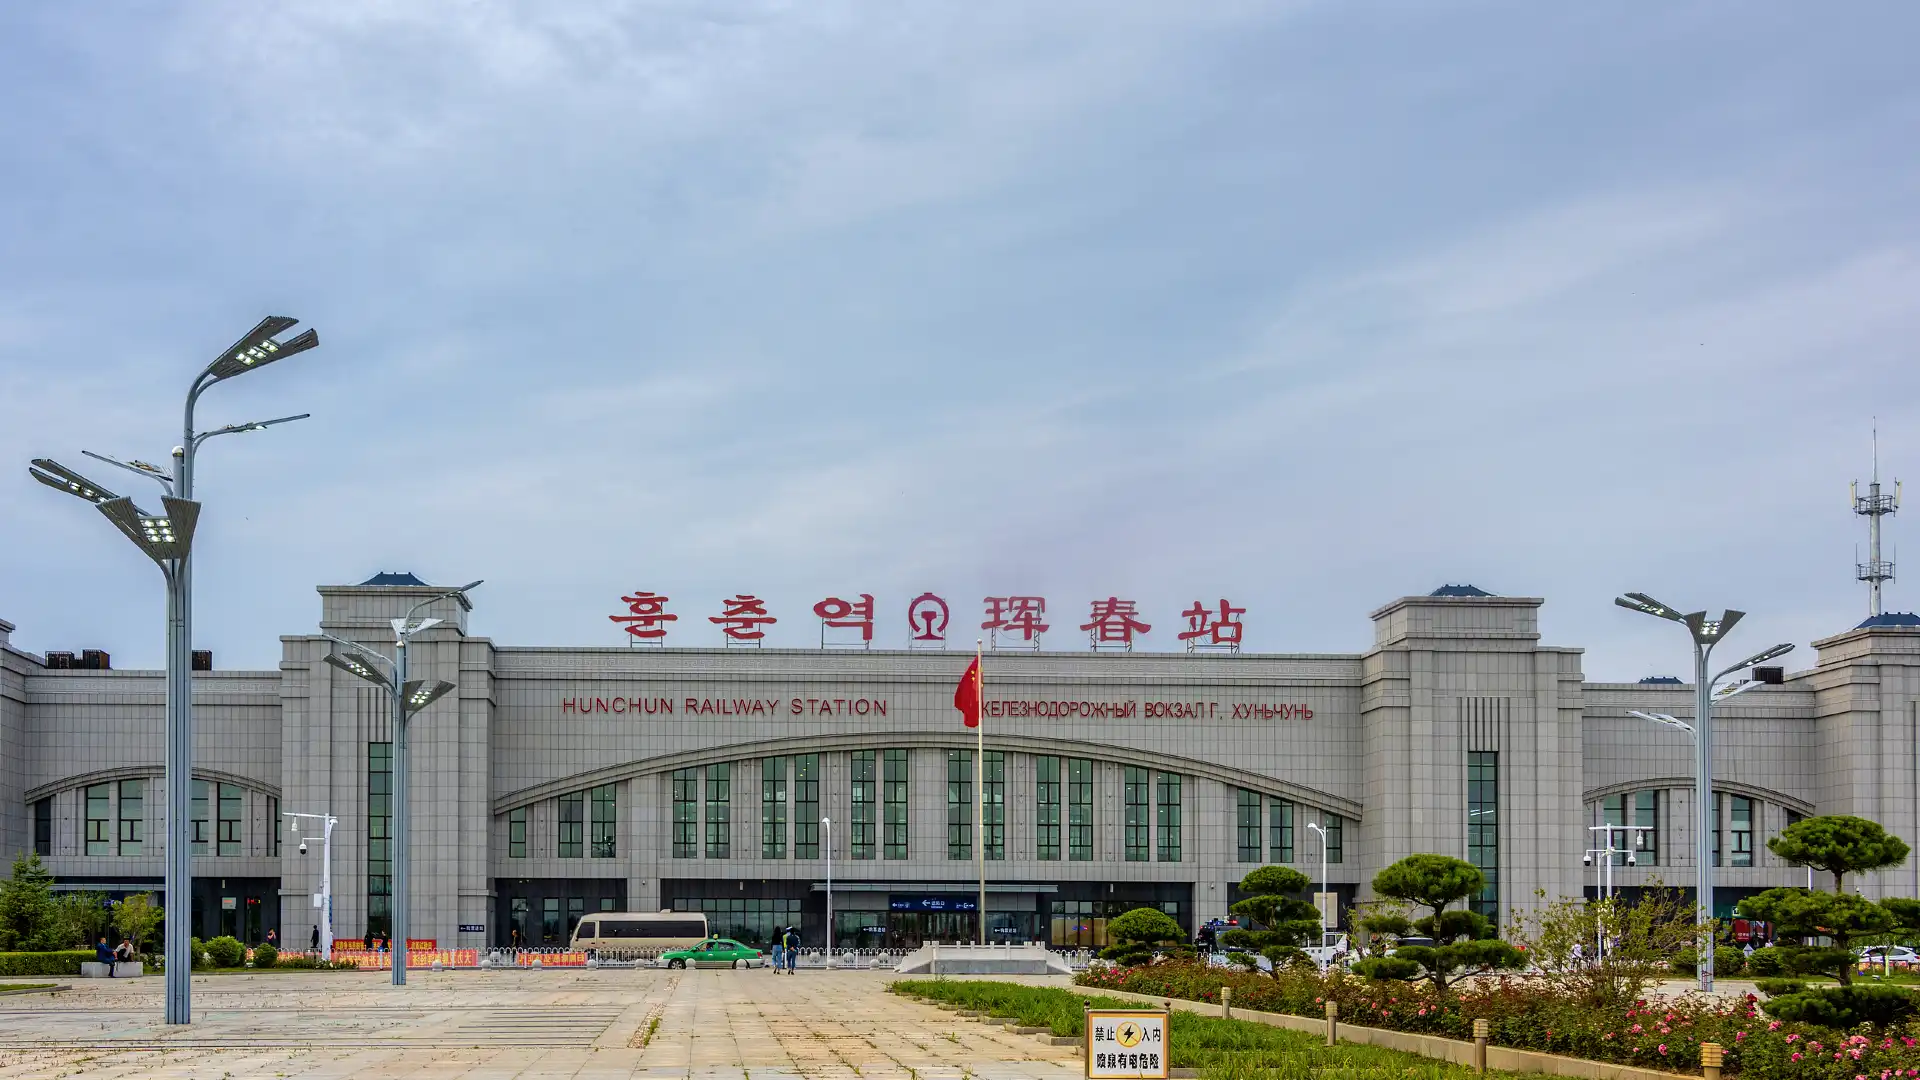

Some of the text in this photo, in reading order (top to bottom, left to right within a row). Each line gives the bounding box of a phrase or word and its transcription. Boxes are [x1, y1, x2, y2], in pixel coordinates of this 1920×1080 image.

[608, 591, 875, 641] 훈춘역
[980, 596, 1246, 644] 珲春站
[562, 697, 887, 717] HUNCHUN RAILWAY STATION
[1144, 701, 1205, 718] ВОКЗАЛ
[1232, 703, 1314, 720] ХУНЬЧУНЬ
[1095, 1026, 1161, 1042] 禁止 入内
